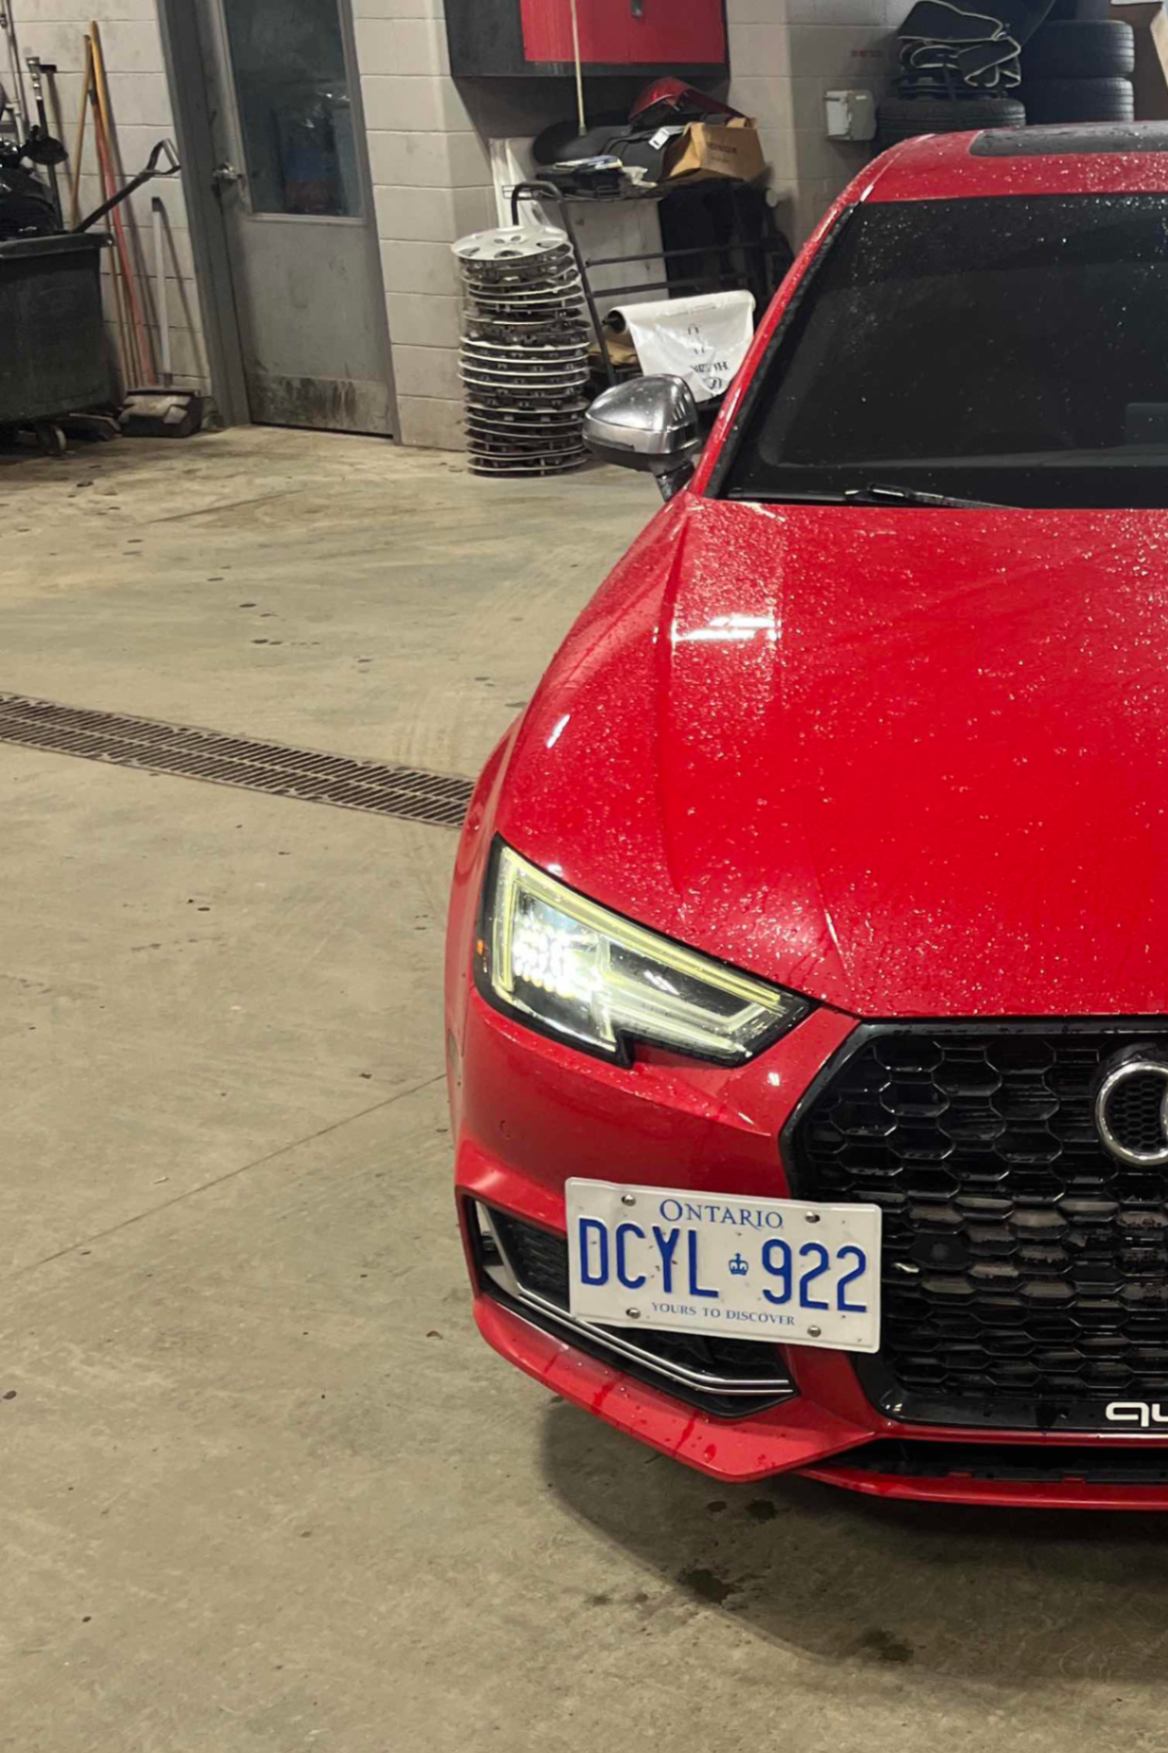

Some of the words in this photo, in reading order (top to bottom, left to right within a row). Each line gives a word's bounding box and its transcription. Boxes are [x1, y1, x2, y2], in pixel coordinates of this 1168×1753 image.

[659, 1199, 783, 1230] ONTARIO
[578, 1217, 719, 1298] DCYL
[761, 1238, 868, 1313] 922
[651, 1302, 697, 1316] YOURS
[703, 1307, 721, 1319] TO
[726, 1310, 796, 1326] DISCOVER
